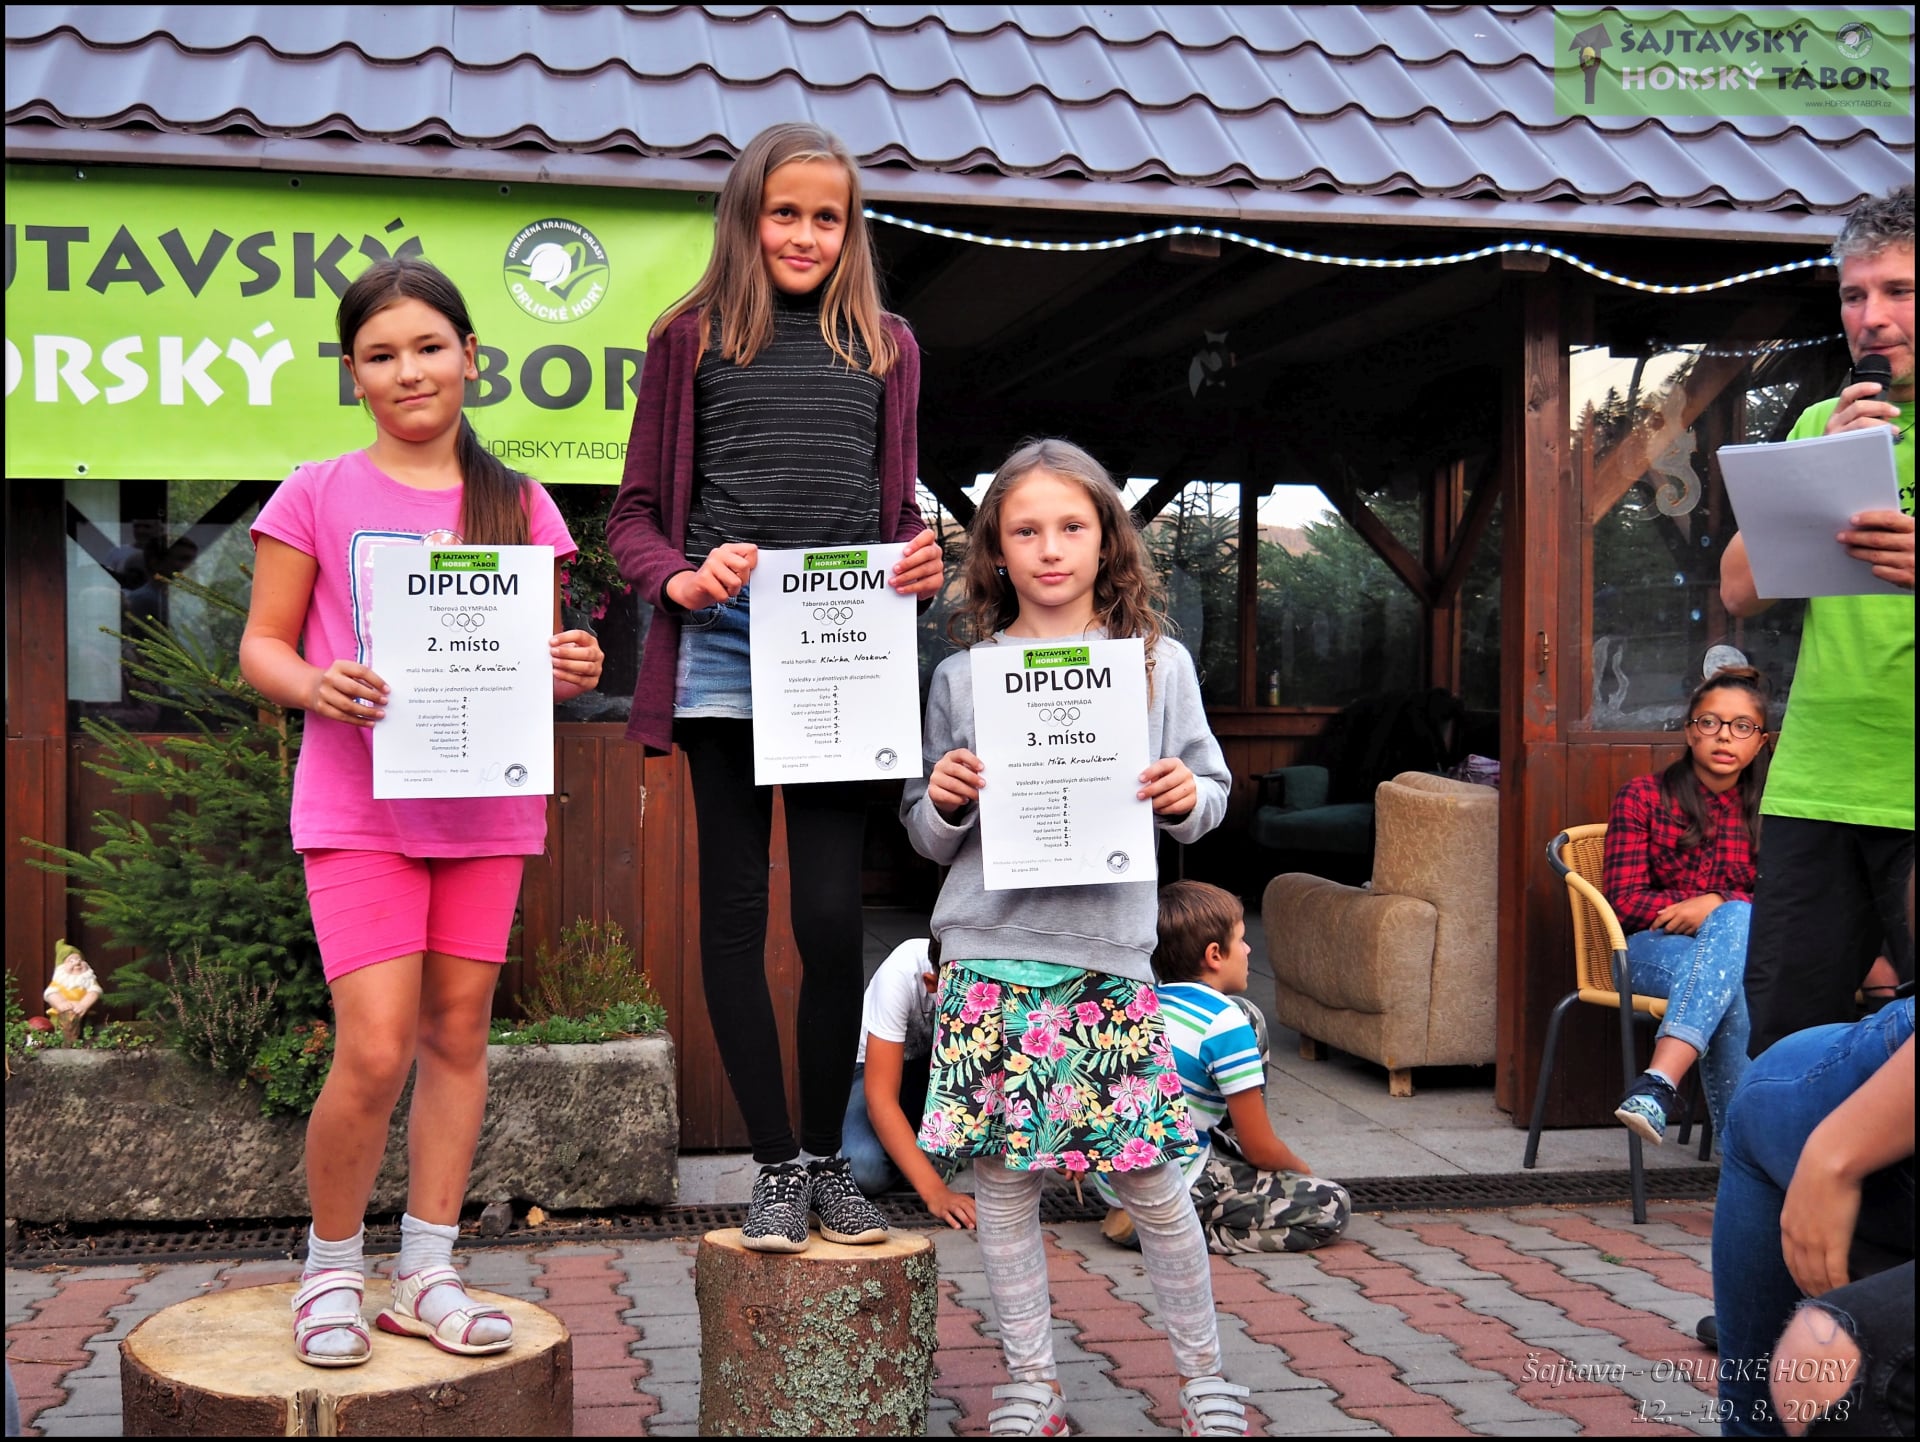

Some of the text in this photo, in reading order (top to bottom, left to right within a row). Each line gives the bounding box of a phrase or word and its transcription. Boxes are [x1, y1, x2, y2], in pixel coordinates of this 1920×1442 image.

[582, 232, 605, 260] OBLAST
[512, 282, 603, 321] ORLICKÉ HORY
[5, 320, 295, 407] RSKÝ
[408, 573, 518, 596] DIPLOM
[783, 569, 885, 593] DIPLOM
[427, 636, 500, 652] 2. místo
[800, 628, 867, 644] 1. místo
[1005, 667, 1111, 693] DIPLOM
[1027, 730, 1096, 746] 3. místo
